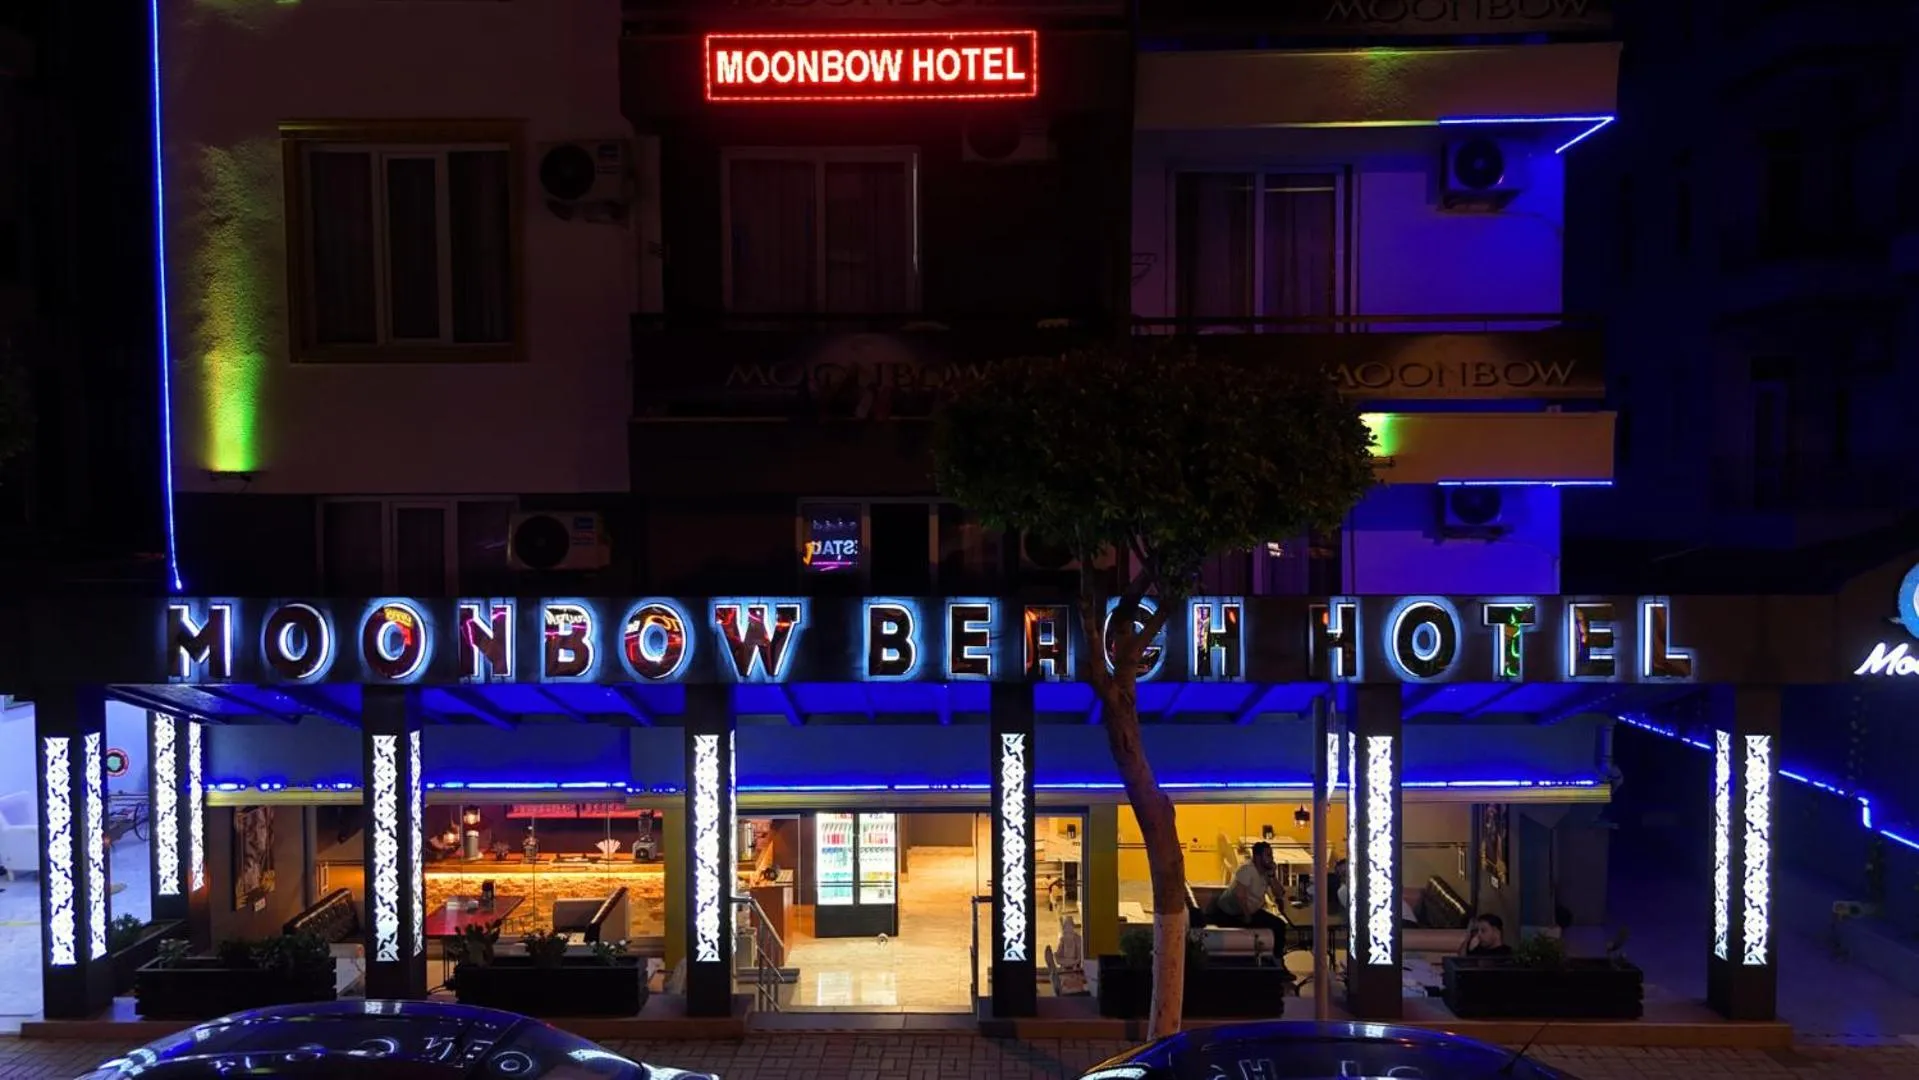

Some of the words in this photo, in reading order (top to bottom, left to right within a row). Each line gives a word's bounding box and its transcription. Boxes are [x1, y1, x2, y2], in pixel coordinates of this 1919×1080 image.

[716, 48, 903, 84] MOONBOW
[912, 46, 1026, 82] HOTEL
[167, 602, 801, 679] MOONBOW
[867, 602, 1241, 678] BEACH
[1307, 601, 1692, 678] HOTEL
